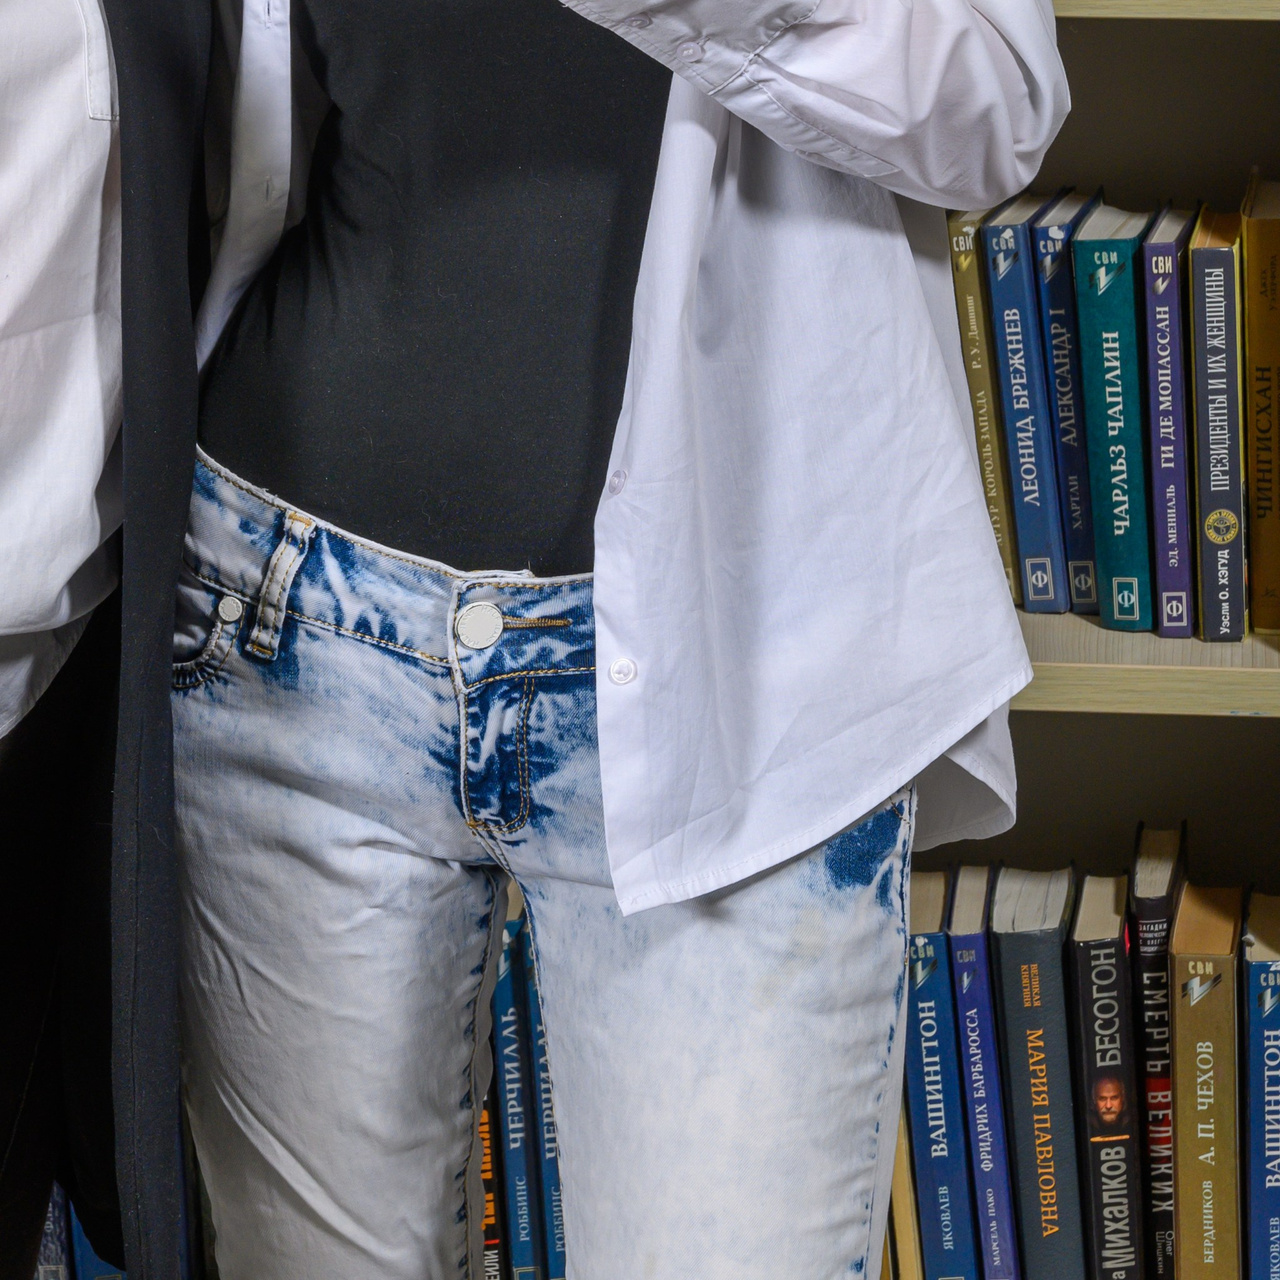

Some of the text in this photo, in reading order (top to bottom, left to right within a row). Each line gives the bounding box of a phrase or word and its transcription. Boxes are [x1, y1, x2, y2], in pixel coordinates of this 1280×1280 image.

[1204, 267, 1227, 350] ЖЕНЩИНЫ
[1004, 308, 1041, 507] ЛЕОНИД БРЕЖНЕВ
[1156, 306, 1176, 468] ГИ ДЕ МОПАССАН
[1206, 354, 1226, 374] ИХ
[1208, 378, 1227, 389] И
[1102, 331, 1130, 536] ЧАРЛЬЗ ЧАПЛИН
[1208, 395, 1231, 492] ПРЕЗИДЕНТЫ
[1218, 549, 1230, 586] ХЭГУД
[1218, 602, 1231, 635] Уэсли
[1020, 964, 1032, 1008] КНЯГИНЯ
[1030, 963, 1042, 1008] ВЕЛИКАЯ
[1090, 947, 1122, 1068] БЕСОГОН
[1142, 971, 1171, 1072] СМЕРТЬ
[500, 1006, 526, 1152] ЧЕРЧИЛЛЬ
[918, 1000, 949, 1158] ВАШИНГТОН
[966, 1008, 994, 1172] ФРИДРИХ БАРБАРОССА
[1196, 1041, 1215, 1166] А. П. ЧЕХОВ
[1026, 1028, 1060, 1238] МАРИЯ ПАВЛОВНА
[1147, 1090, 1174, 1213] ВЕЛИКИХ
[518, 1176, 531, 1242] РОББИНС
[938, 1185, 954, 1251] ЯКОВЛЕВ
[986, 1188, 1001, 1266] МАРСЕЛЬ ПАКО
[1100, 1145, 1136, 1270] Михалков
[1202, 1180, 1216, 1264] БЕРДНИКОВ
